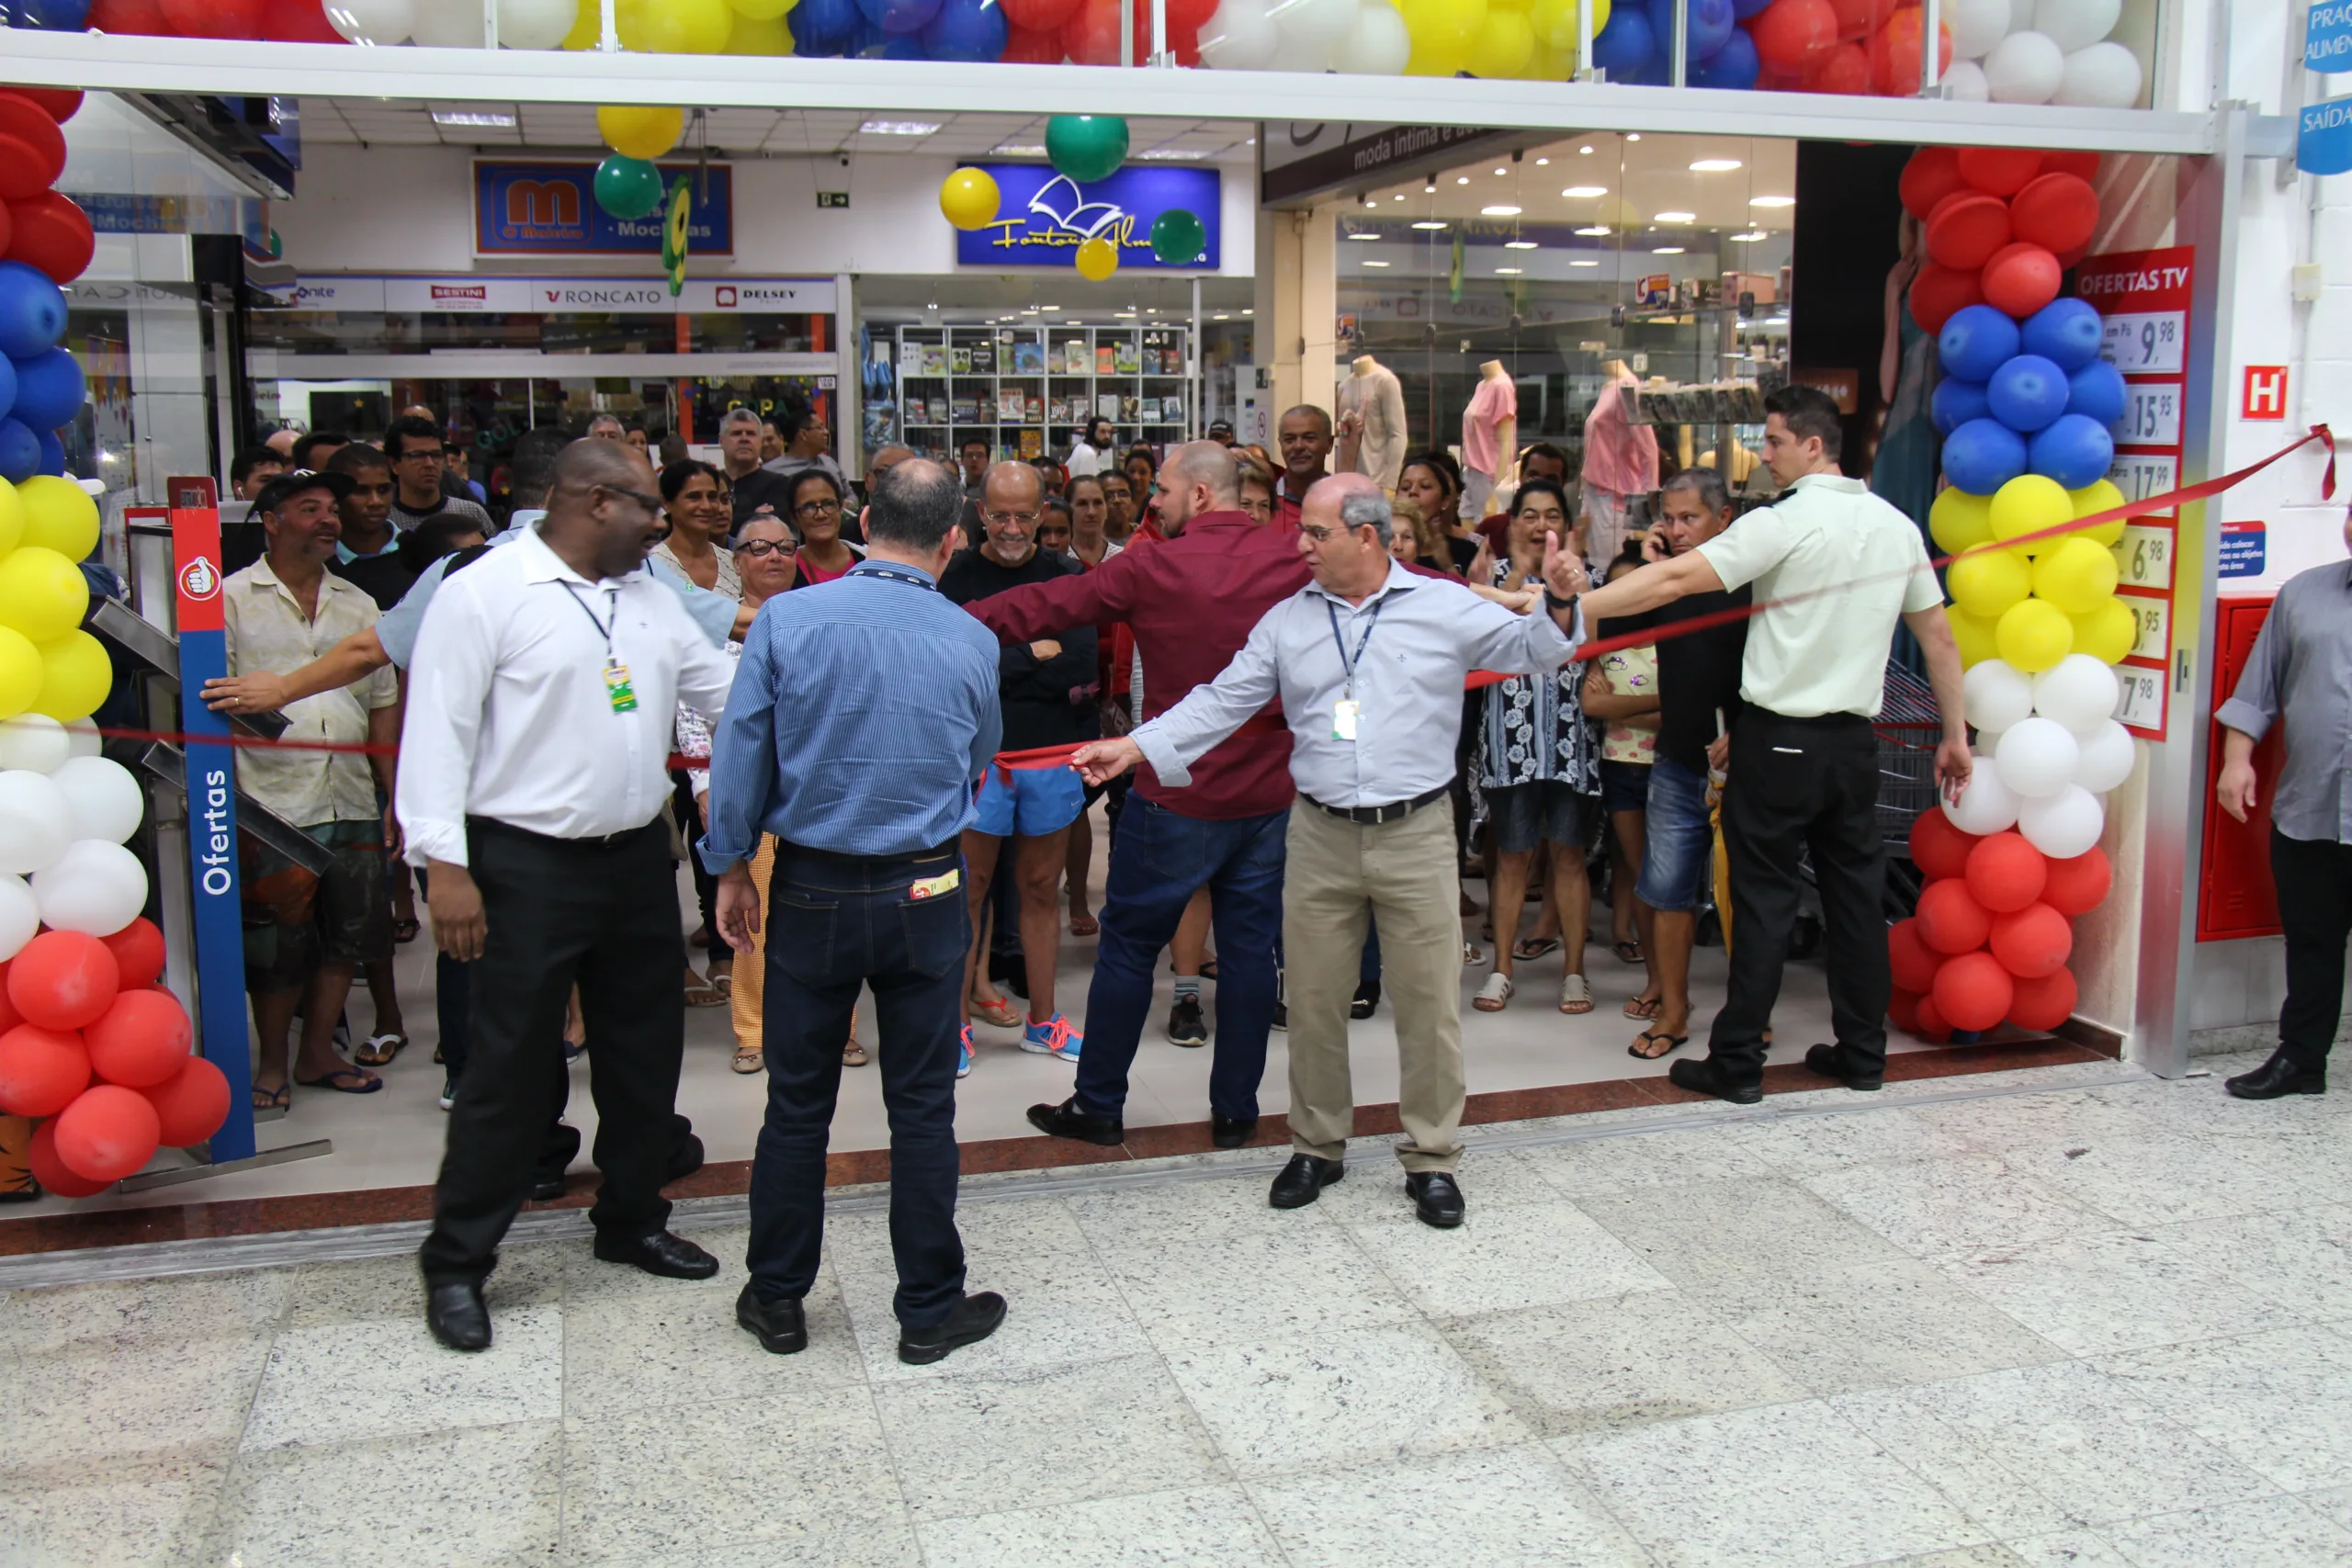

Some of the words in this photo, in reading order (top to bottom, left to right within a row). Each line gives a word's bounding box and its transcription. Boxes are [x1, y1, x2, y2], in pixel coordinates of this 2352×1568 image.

[1354, 146, 1391, 170] moda
[617, 220, 712, 238] Mocas
[2080, 269, 2160, 296] OFERTAS
[2162, 265, 2188, 290] TV
[434, 288, 483, 298] SESTINI
[565, 289, 662, 304] RONCATO
[742, 289, 797, 299] DELSEY
[2249, 373, 2279, 412] H
[202, 770, 232, 896] Ofertas
